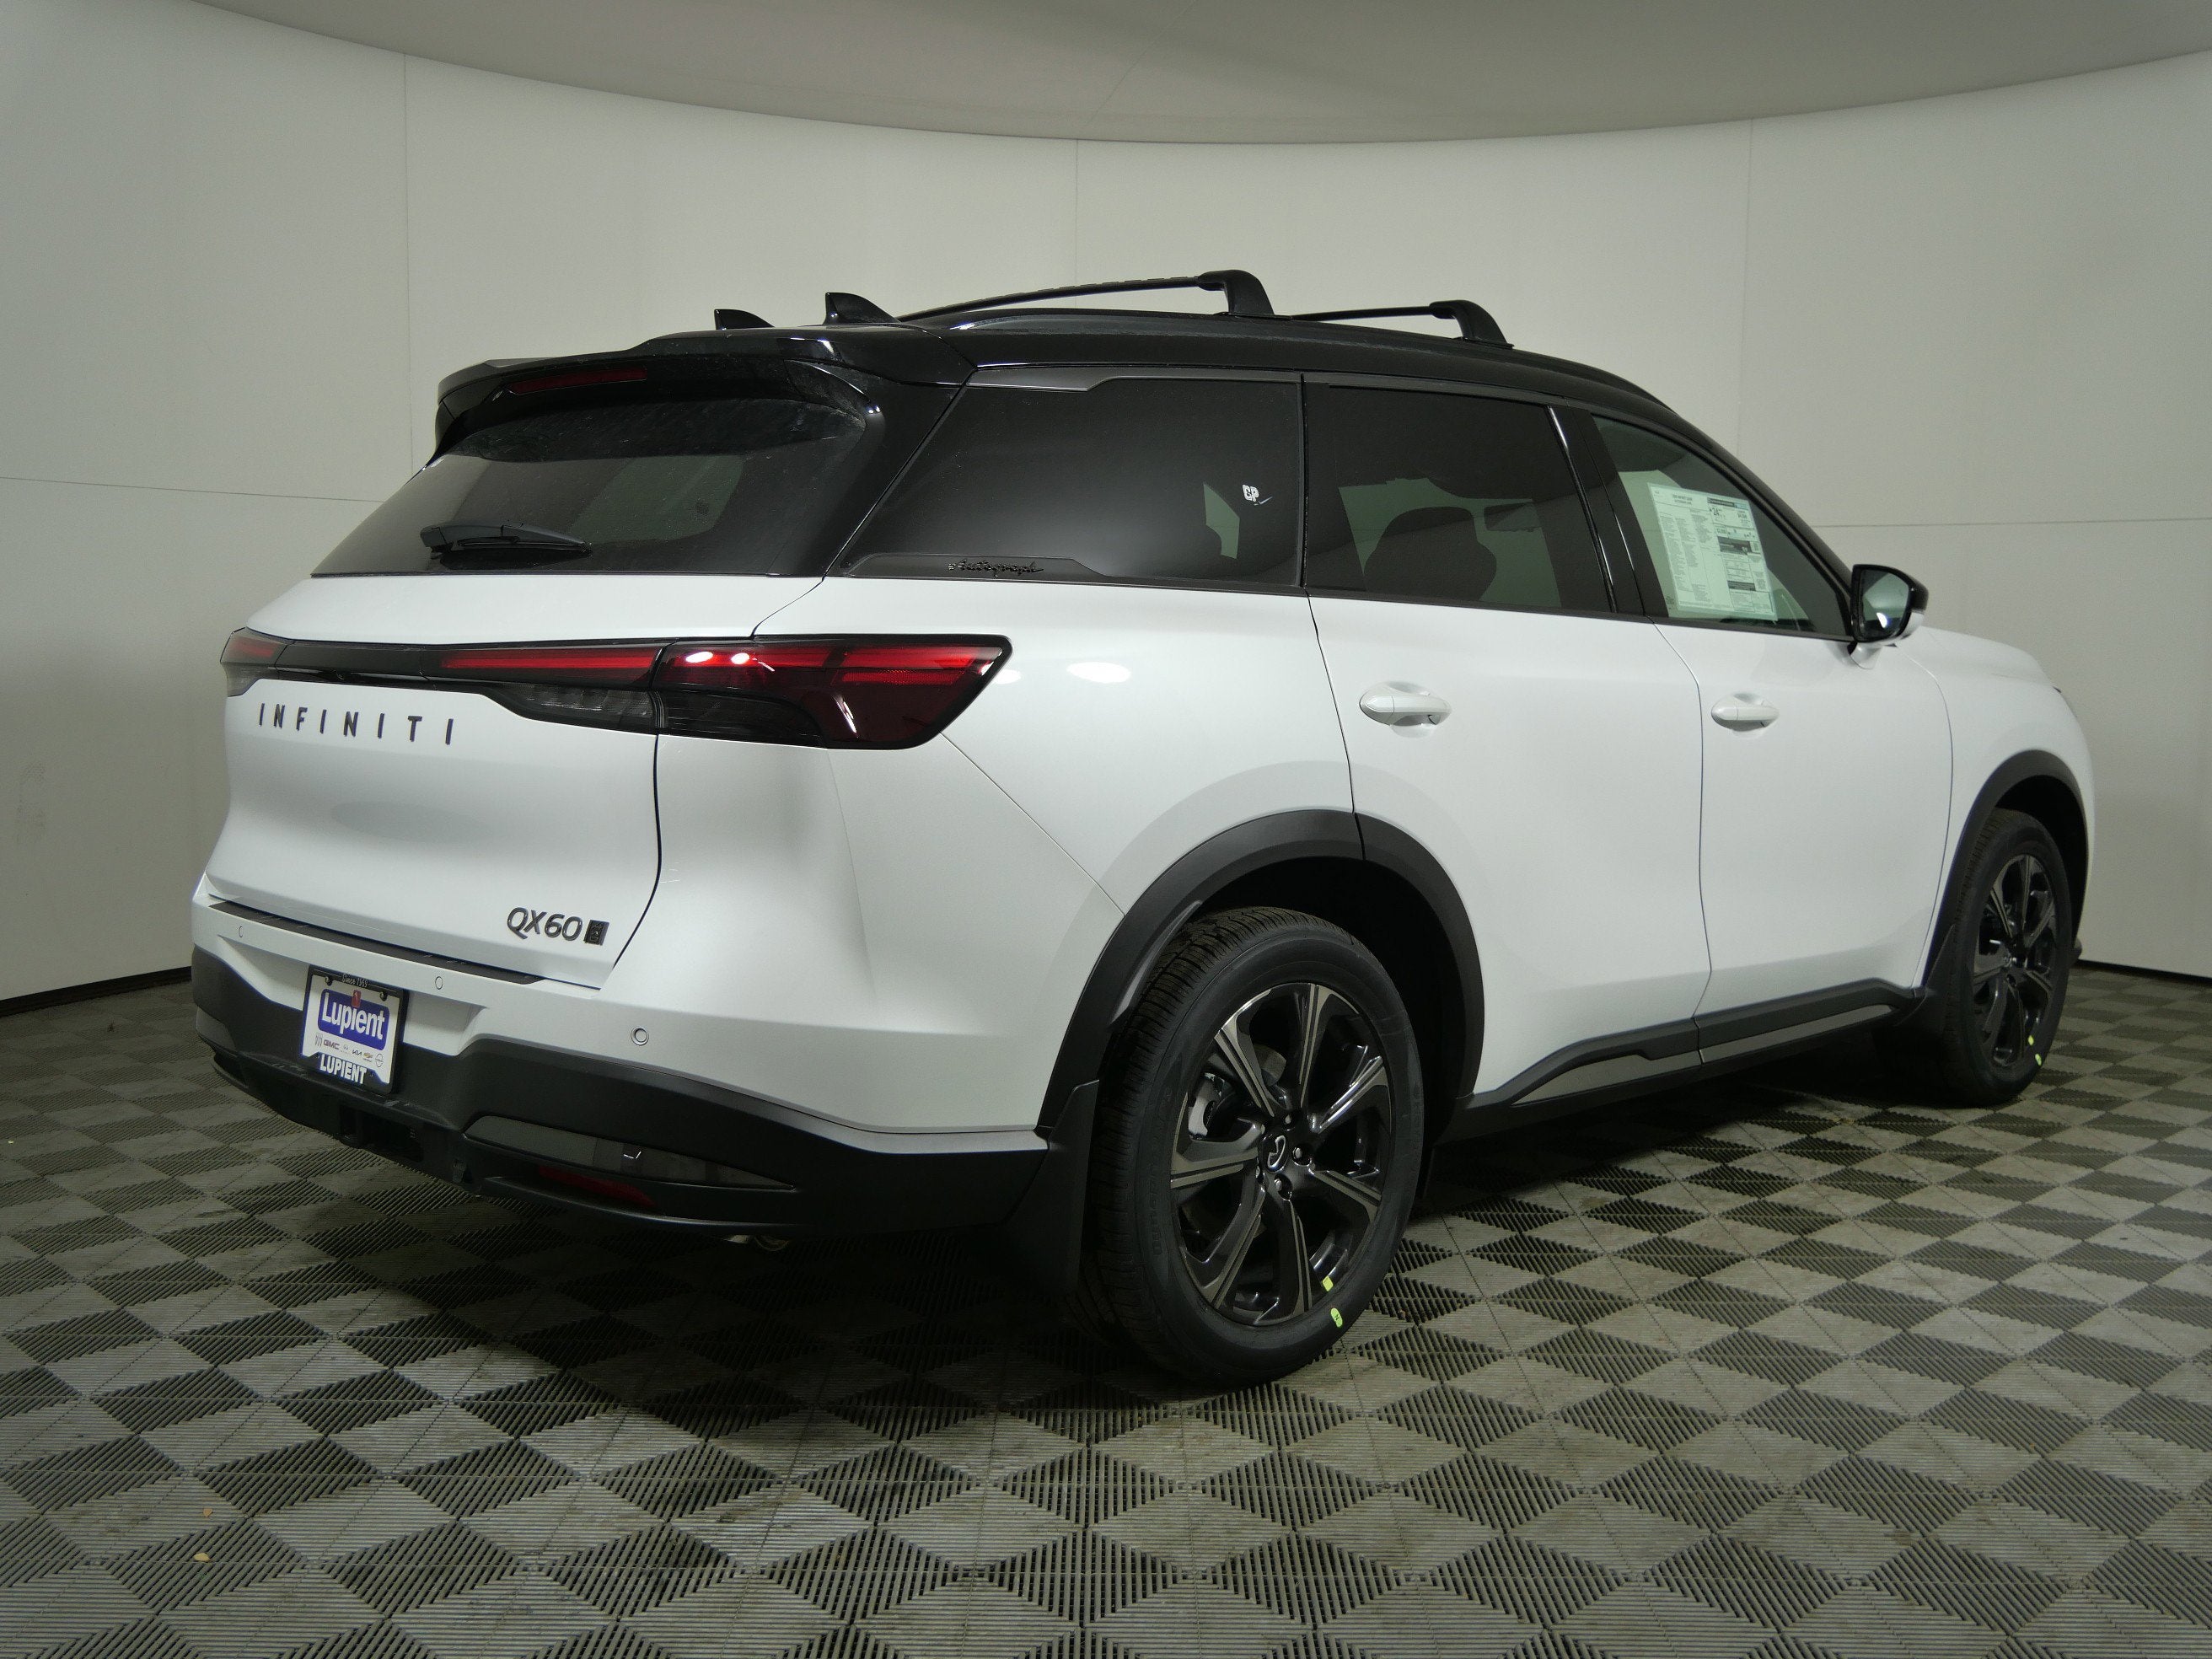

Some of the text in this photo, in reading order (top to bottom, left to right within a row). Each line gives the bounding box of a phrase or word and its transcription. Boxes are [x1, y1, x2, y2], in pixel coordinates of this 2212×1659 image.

[259, 702, 454, 745] INFINITI
[507, 906, 583, 942] QX60
[321, 991, 386, 1040] Lupient
[323, 1039, 340, 1050] GMC
[319, 1053, 368, 1085] LUPIENT
